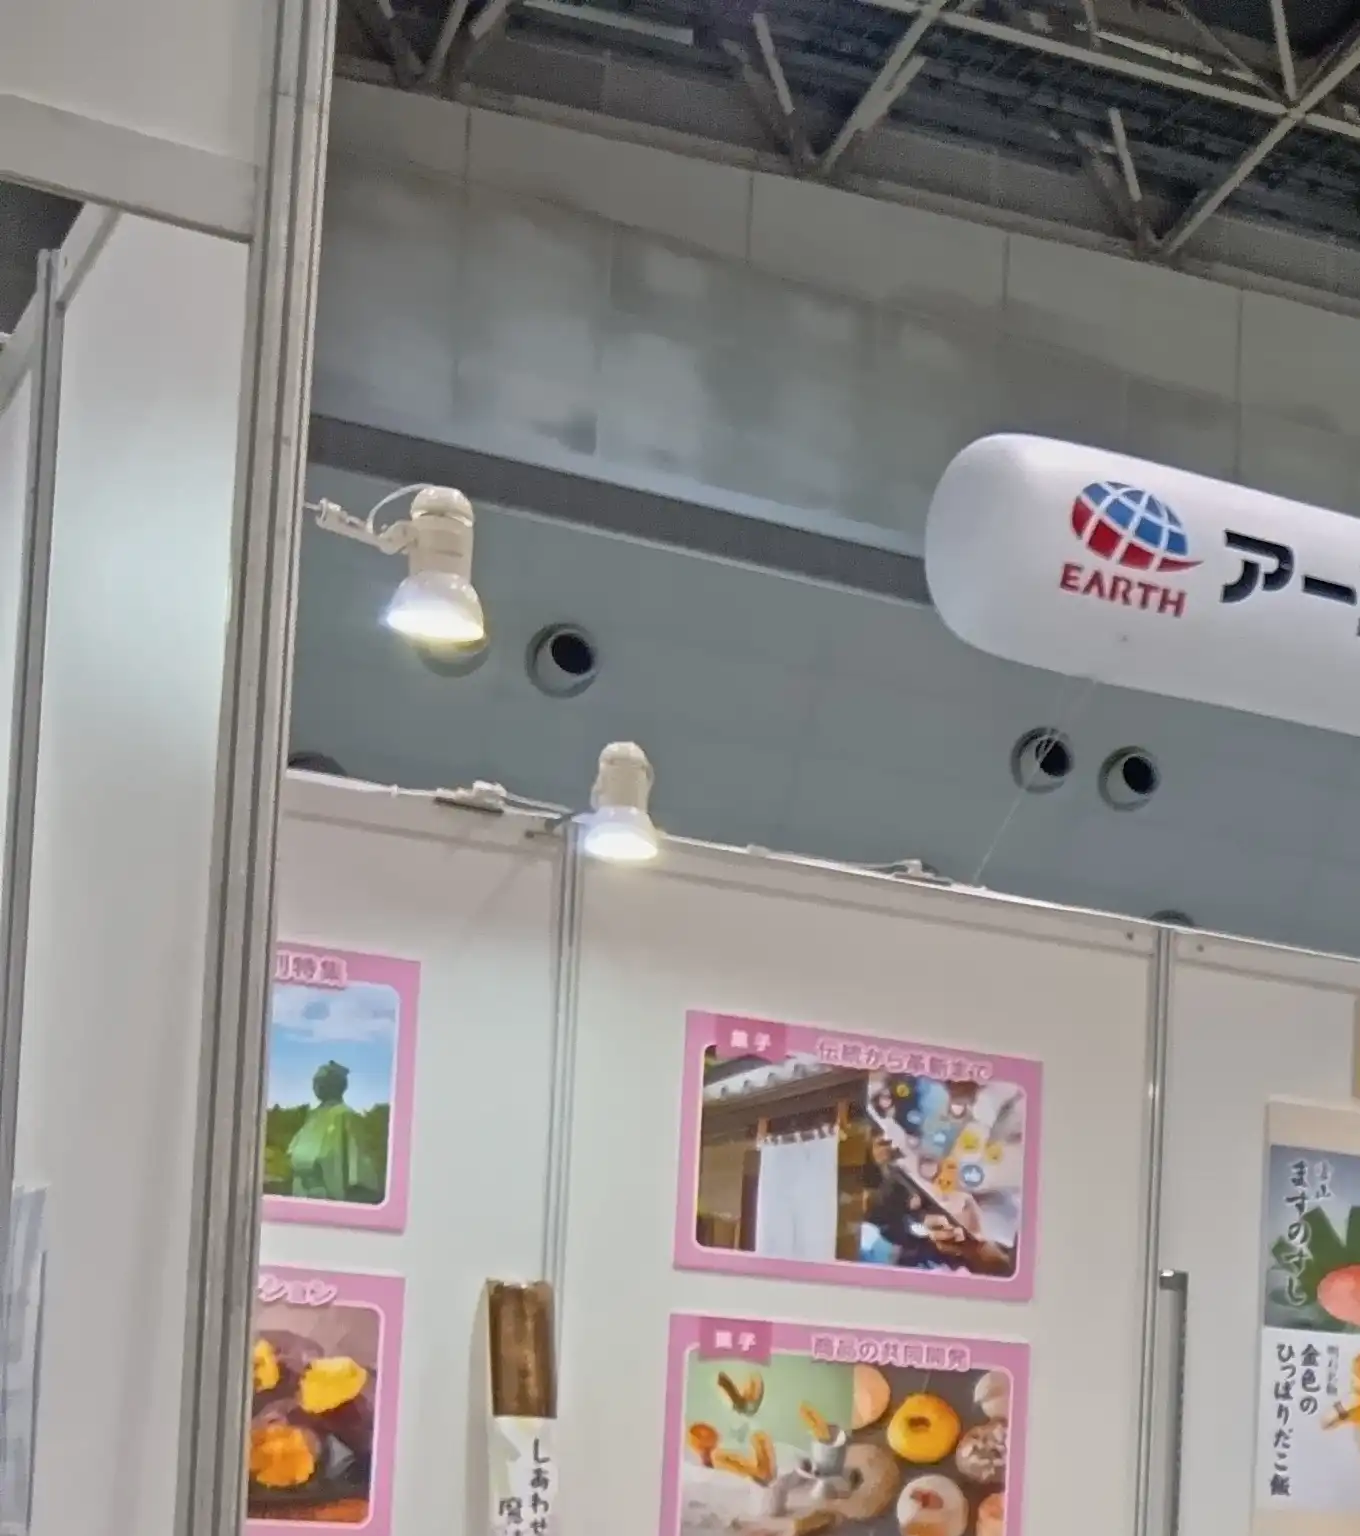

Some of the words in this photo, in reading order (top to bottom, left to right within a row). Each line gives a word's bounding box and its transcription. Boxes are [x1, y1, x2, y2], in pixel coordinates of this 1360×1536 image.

[1059, 563, 1187, 617] EARTH
[1300, 1343, 1321, 1416] 金色の
